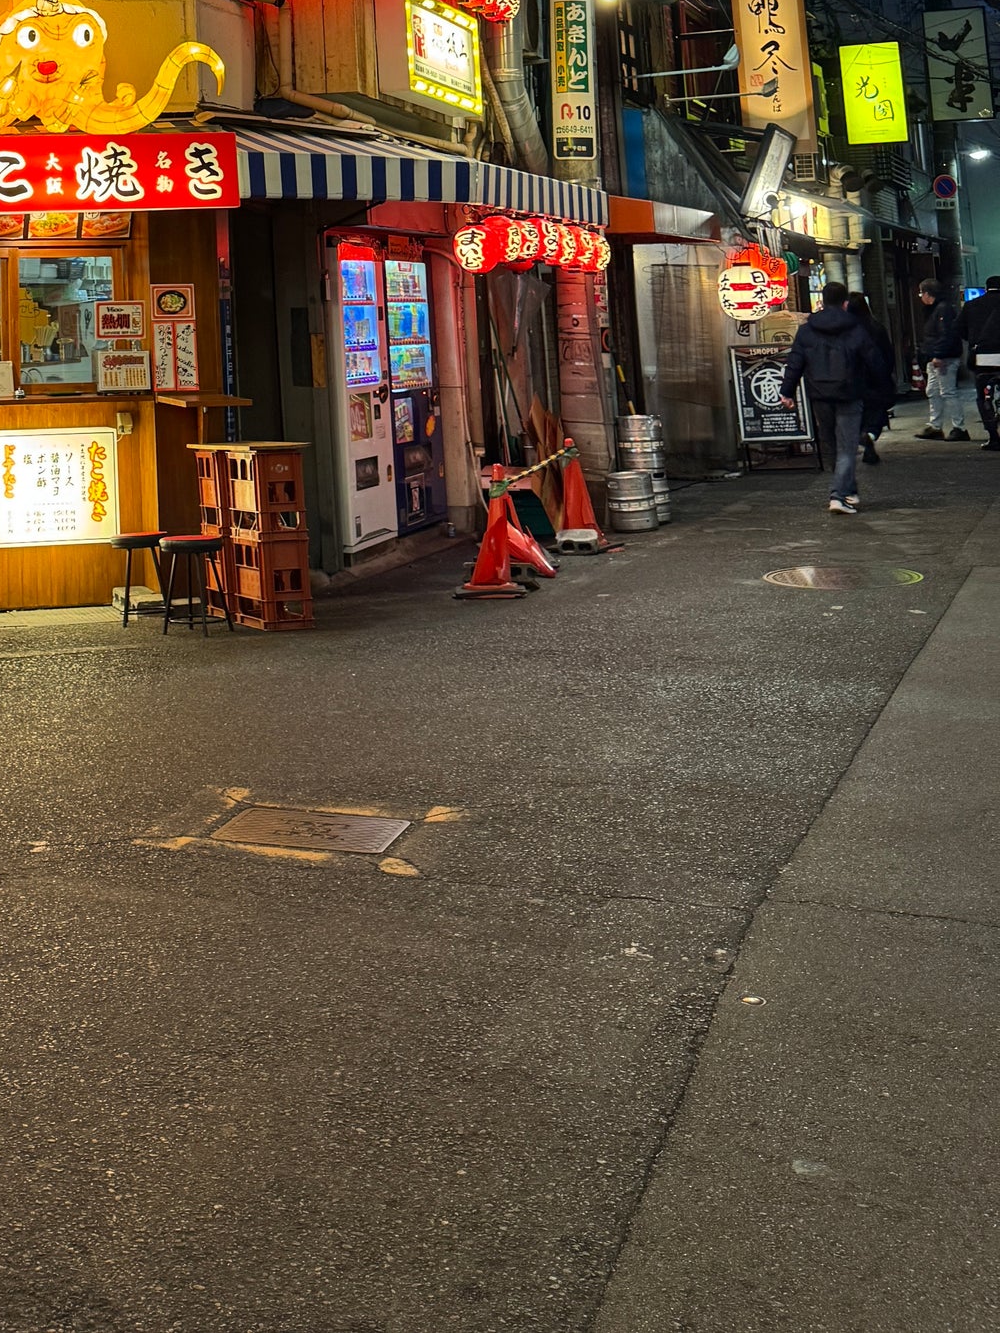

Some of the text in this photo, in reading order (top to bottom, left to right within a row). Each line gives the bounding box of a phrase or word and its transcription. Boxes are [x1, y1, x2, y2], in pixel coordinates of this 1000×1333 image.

[566, 2, 588, 91] あきんど
[576, 105, 591, 120] 10
[154, 150, 174, 193] 名物
[457, 230, 485, 268] まいど
[750, 270, 769, 317] 日本酒
[65, 452, 75, 486] ソース
[87, 440, 109, 522] たこ焼き
